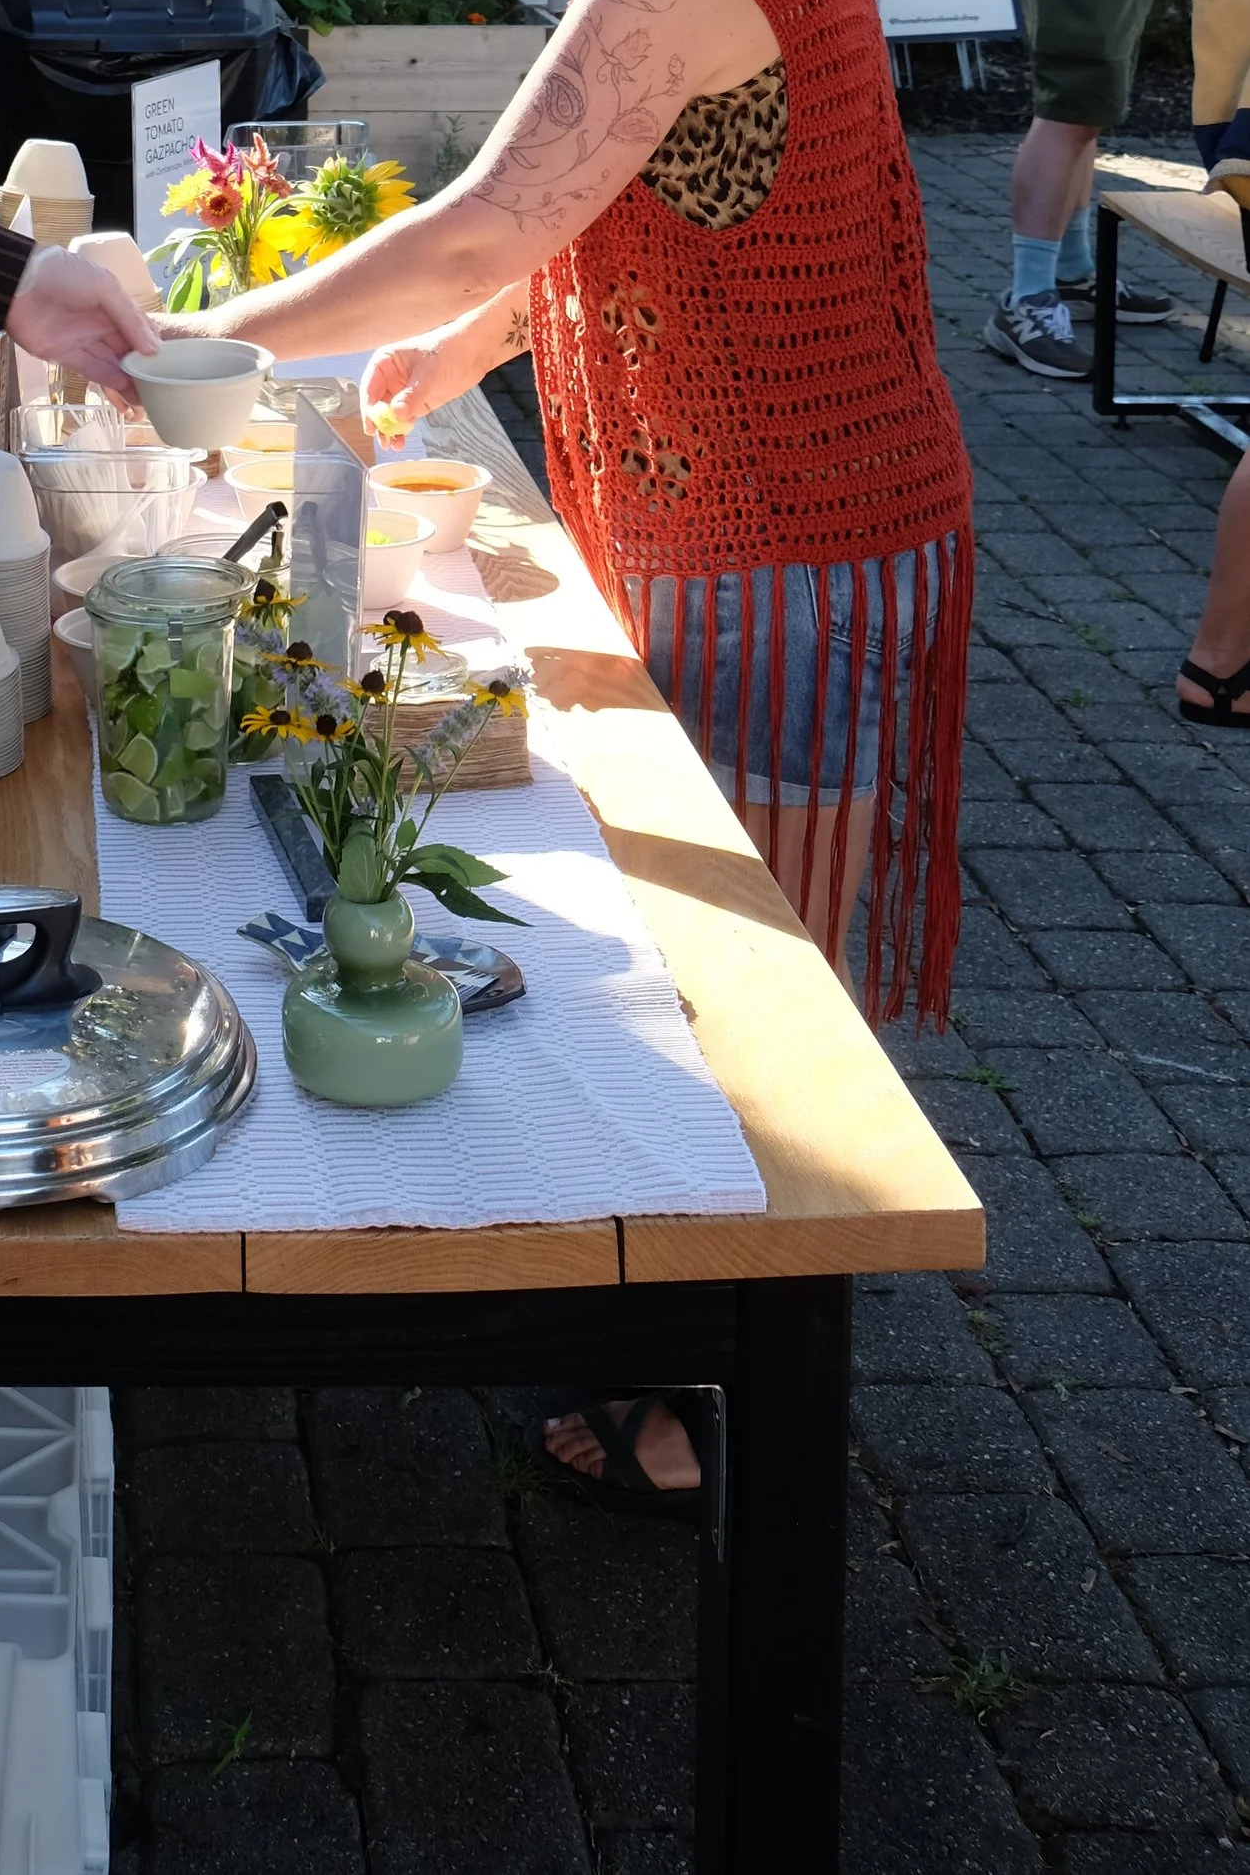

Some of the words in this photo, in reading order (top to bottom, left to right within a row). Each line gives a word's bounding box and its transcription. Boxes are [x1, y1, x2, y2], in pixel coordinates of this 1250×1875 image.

[145, 98, 175, 119] GREEN
[145, 117, 184, 141] TOMATO
[146, 136, 196, 164] GAZPACHO
